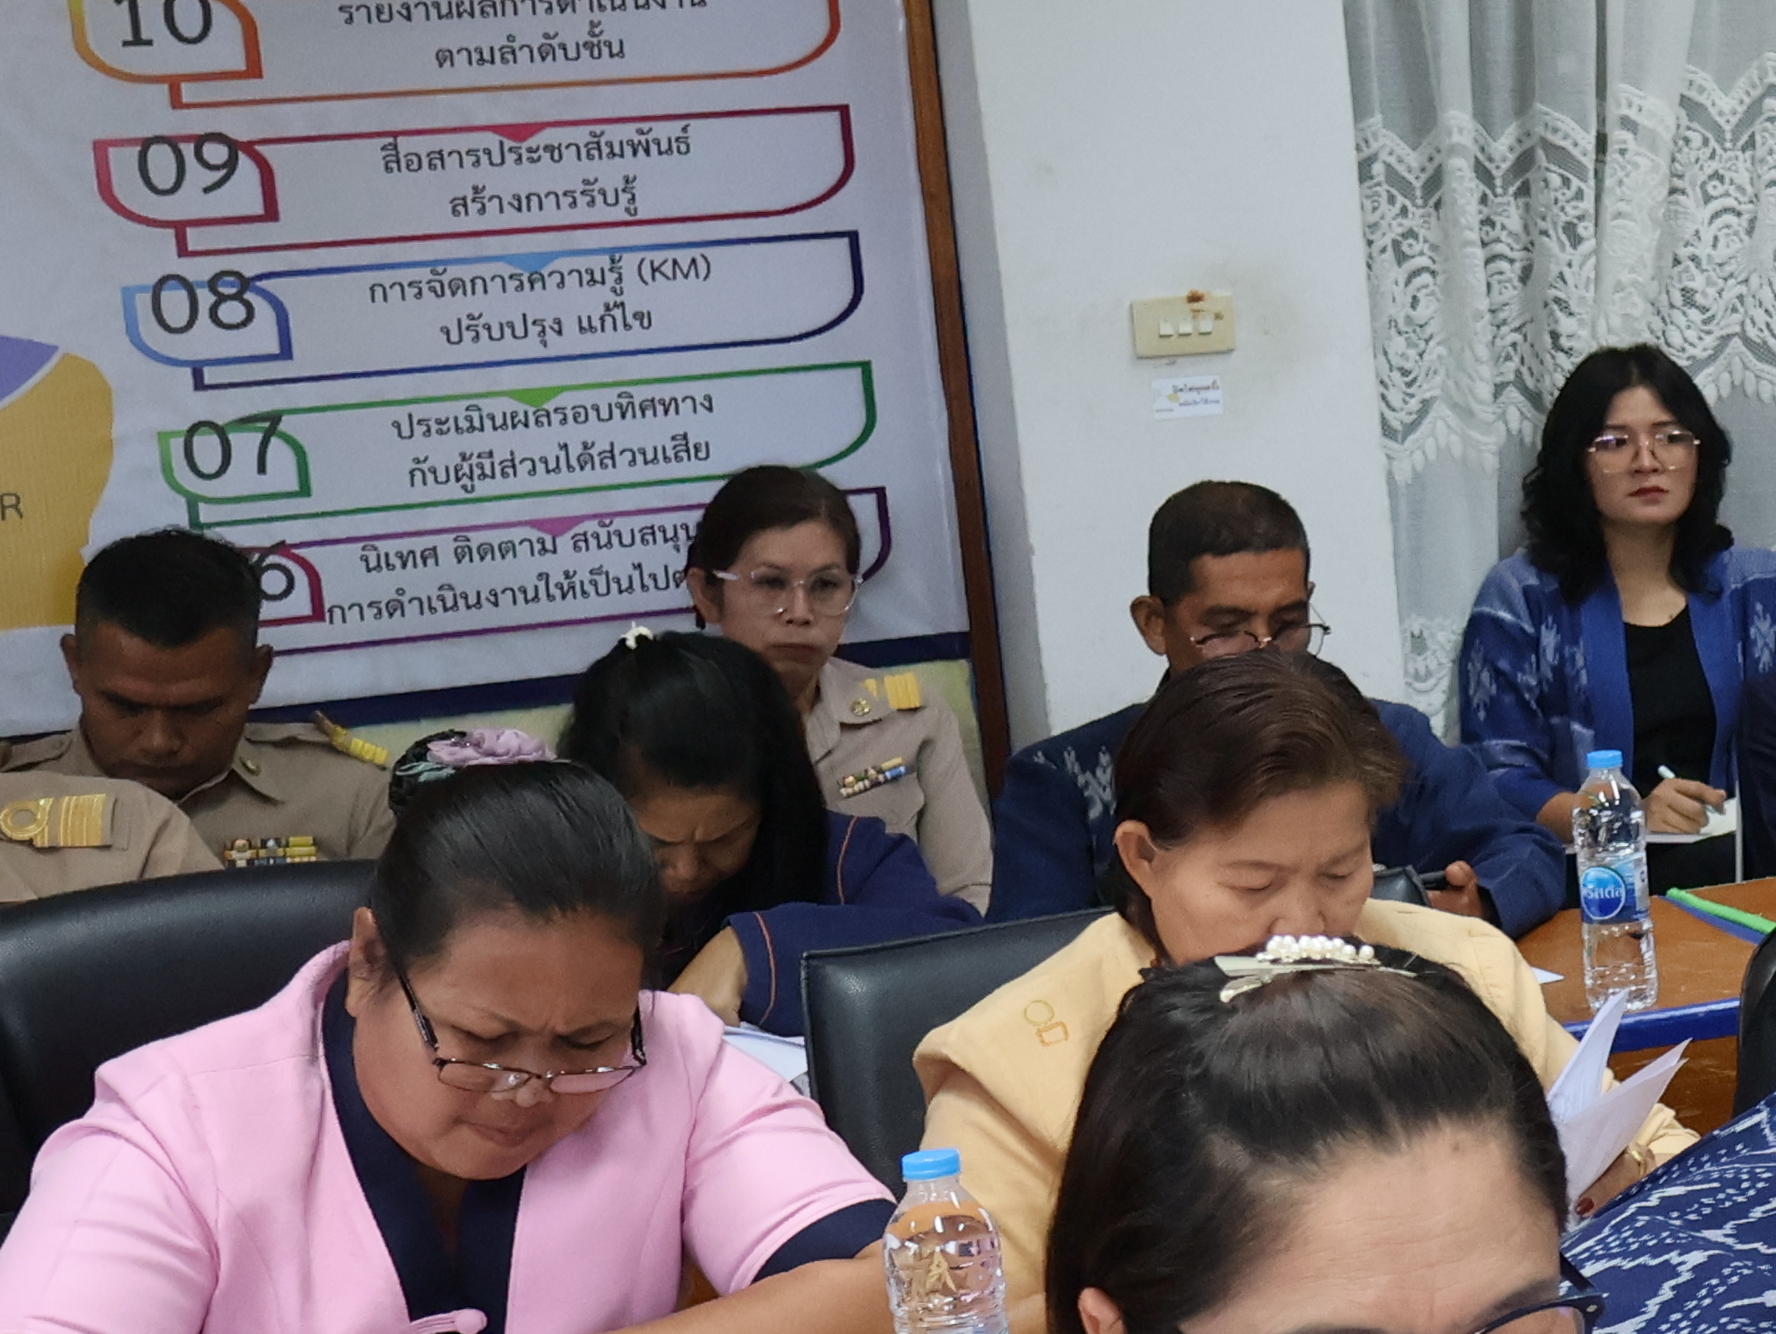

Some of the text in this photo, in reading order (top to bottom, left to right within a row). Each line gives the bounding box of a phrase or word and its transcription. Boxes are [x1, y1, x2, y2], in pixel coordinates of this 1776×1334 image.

[436, 20, 625, 68] ตามลำดับชั้น
[138, 132, 239, 196] 09
[381, 124, 691, 174] สื่อสารประชาสัมพันธ์
[449, 174, 638, 218] สร้างการรับรู้
[151, 270, 256, 335] 08
[369, 253, 712, 304] การจัดการความรู้ (KM)
[440, 300, 653, 348] ปรับปรุง แก้ไข
[392, 390, 715, 441] ประเมินผลรอบทิศทาง
[183, 414, 283, 480] 07
[407, 430, 712, 494] กับผู้มีส่วนได้ส่วนเสีย
[359, 543, 440, 574] นิเทศ
[454, 531, 558, 566] ติดตาม
